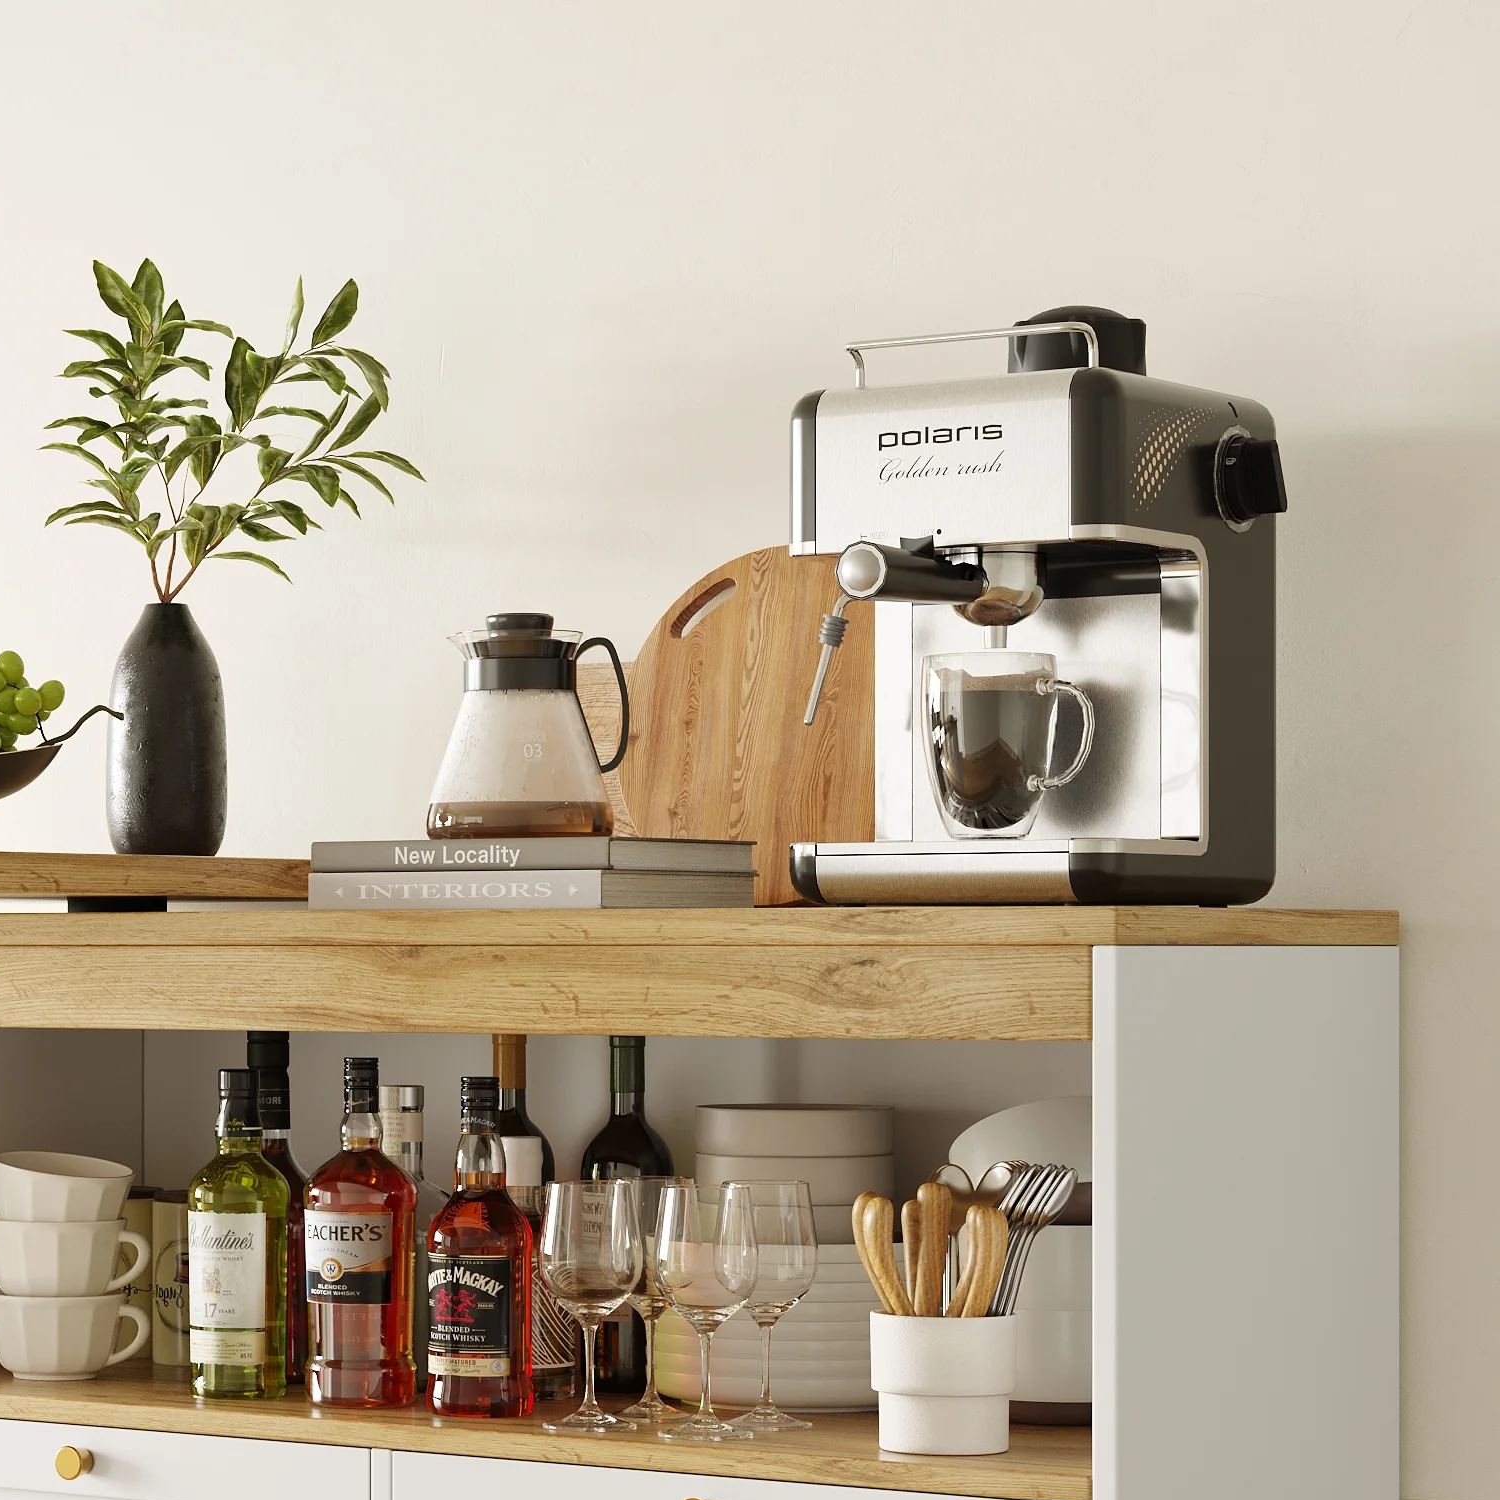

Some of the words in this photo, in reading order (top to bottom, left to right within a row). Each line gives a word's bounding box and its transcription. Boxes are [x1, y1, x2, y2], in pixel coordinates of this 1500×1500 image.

[878, 424, 1003, 451] polaris
[878, 454, 949, 485] Golden
[956, 449, 1005, 476] rush
[523, 743, 543, 758] 03
[393, 845, 436, 865] New
[442, 844, 521, 867] Locality
[357, 882, 553, 900] INTERIORS
[311, 1288, 332, 1296] SCOTCH
[204, 1302, 217, 1318] 17
[430, 1331, 451, 1341] SCOTCH
[452, 1333, 487, 1342] WHISKY
[437, 1324, 471, 1333] BLENDED
